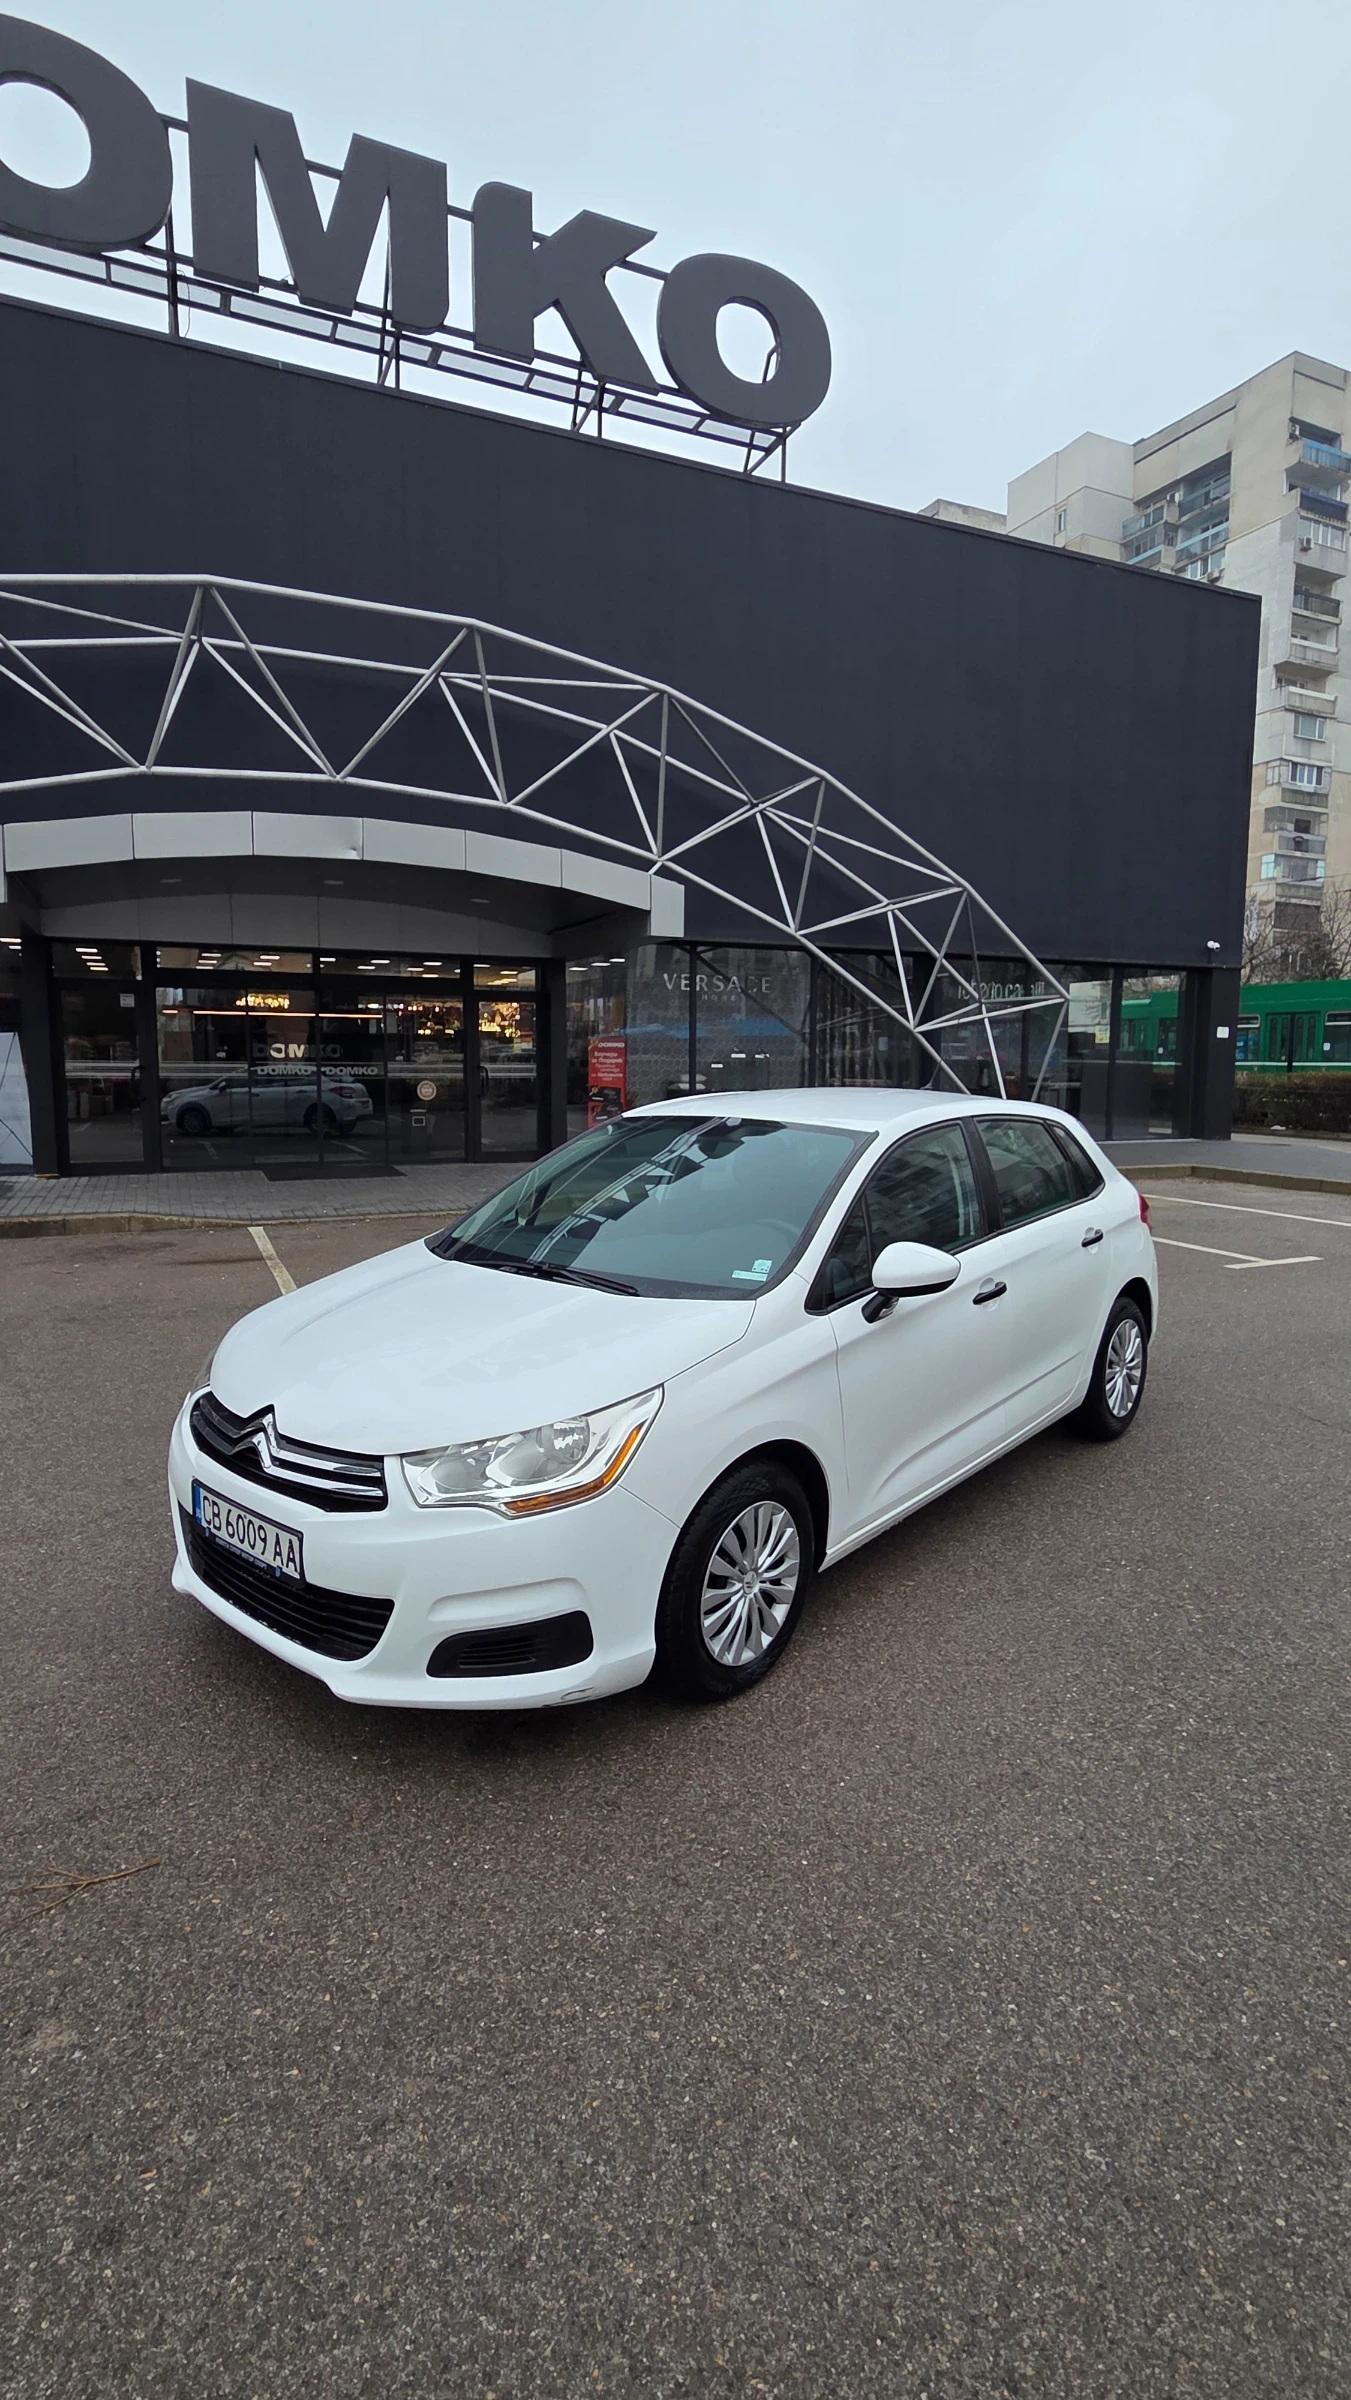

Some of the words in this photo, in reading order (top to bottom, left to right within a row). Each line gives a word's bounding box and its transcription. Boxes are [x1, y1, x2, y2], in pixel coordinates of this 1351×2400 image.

[1005, 981, 1045, 999] caalli
[257, 1065, 312, 1075] DOMKO
[325, 1066, 378, 1075] DOMKO
[203, 1495, 221, 1532] CB
[226, 1509, 267, 1556] 6009
[273, 1532, 299, 1573] AA
